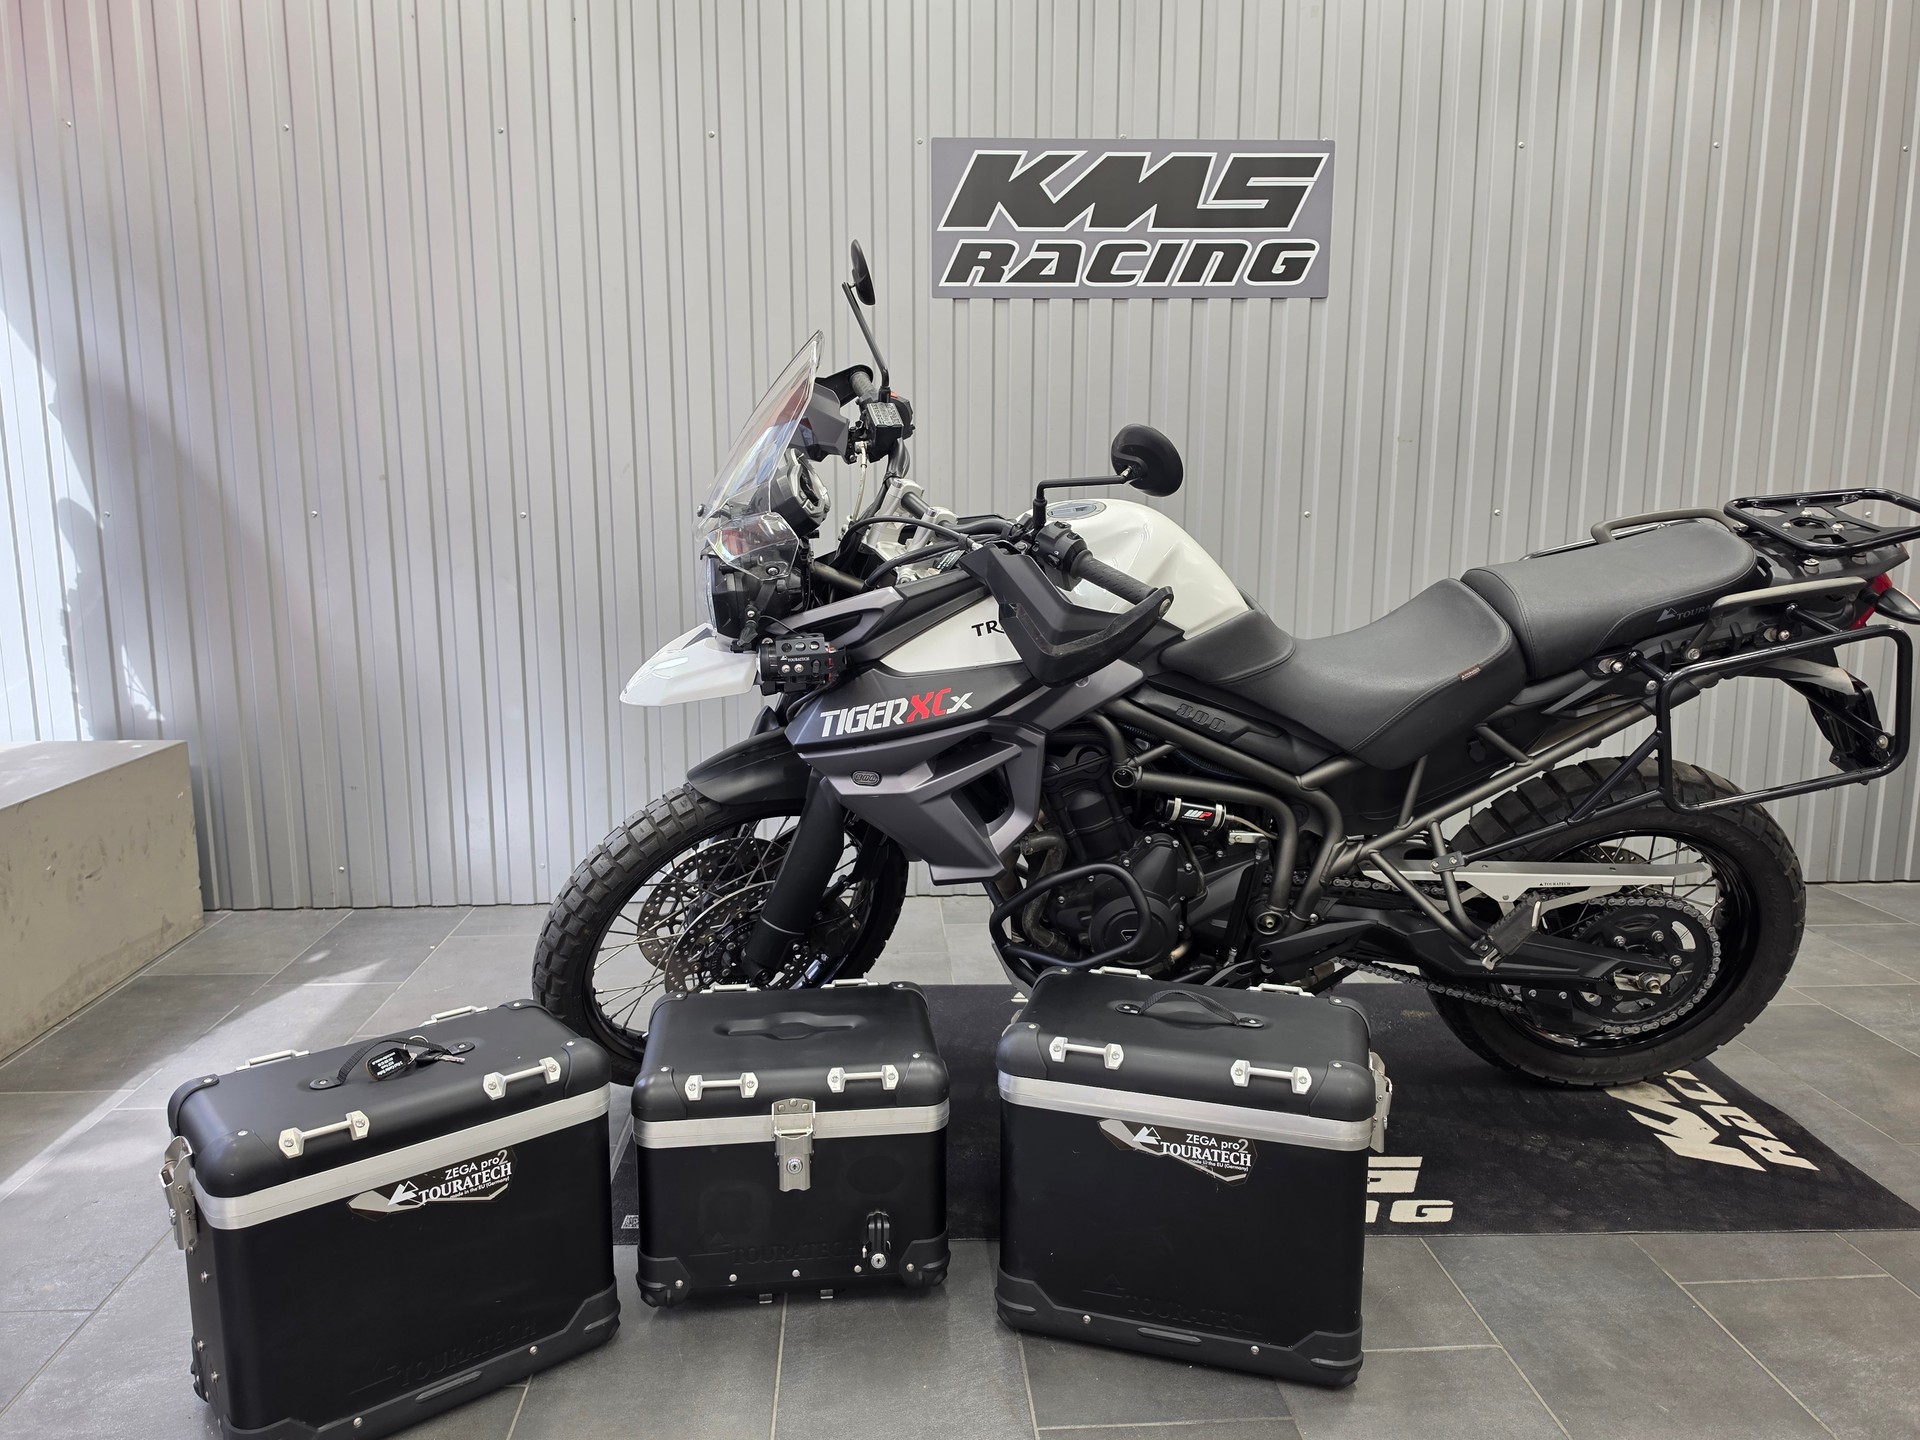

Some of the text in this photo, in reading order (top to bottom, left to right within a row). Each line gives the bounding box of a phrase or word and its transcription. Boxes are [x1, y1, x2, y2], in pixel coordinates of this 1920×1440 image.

[937, 150, 1330, 232] KMS
[938, 239, 1320, 287] RACING
[1676, 604, 1711, 620] TOURA
[971, 620, 1005, 637] TR
[820, 697, 909, 738] TIGER
[1175, 703, 1226, 733] 800
[1160, 1141, 1252, 1167] TOURATECH
[1186, 1133, 1218, 1147] ZEGA
[418, 1162, 512, 1202] TOURATECH
[444, 1162, 478, 1180] ZEGA
